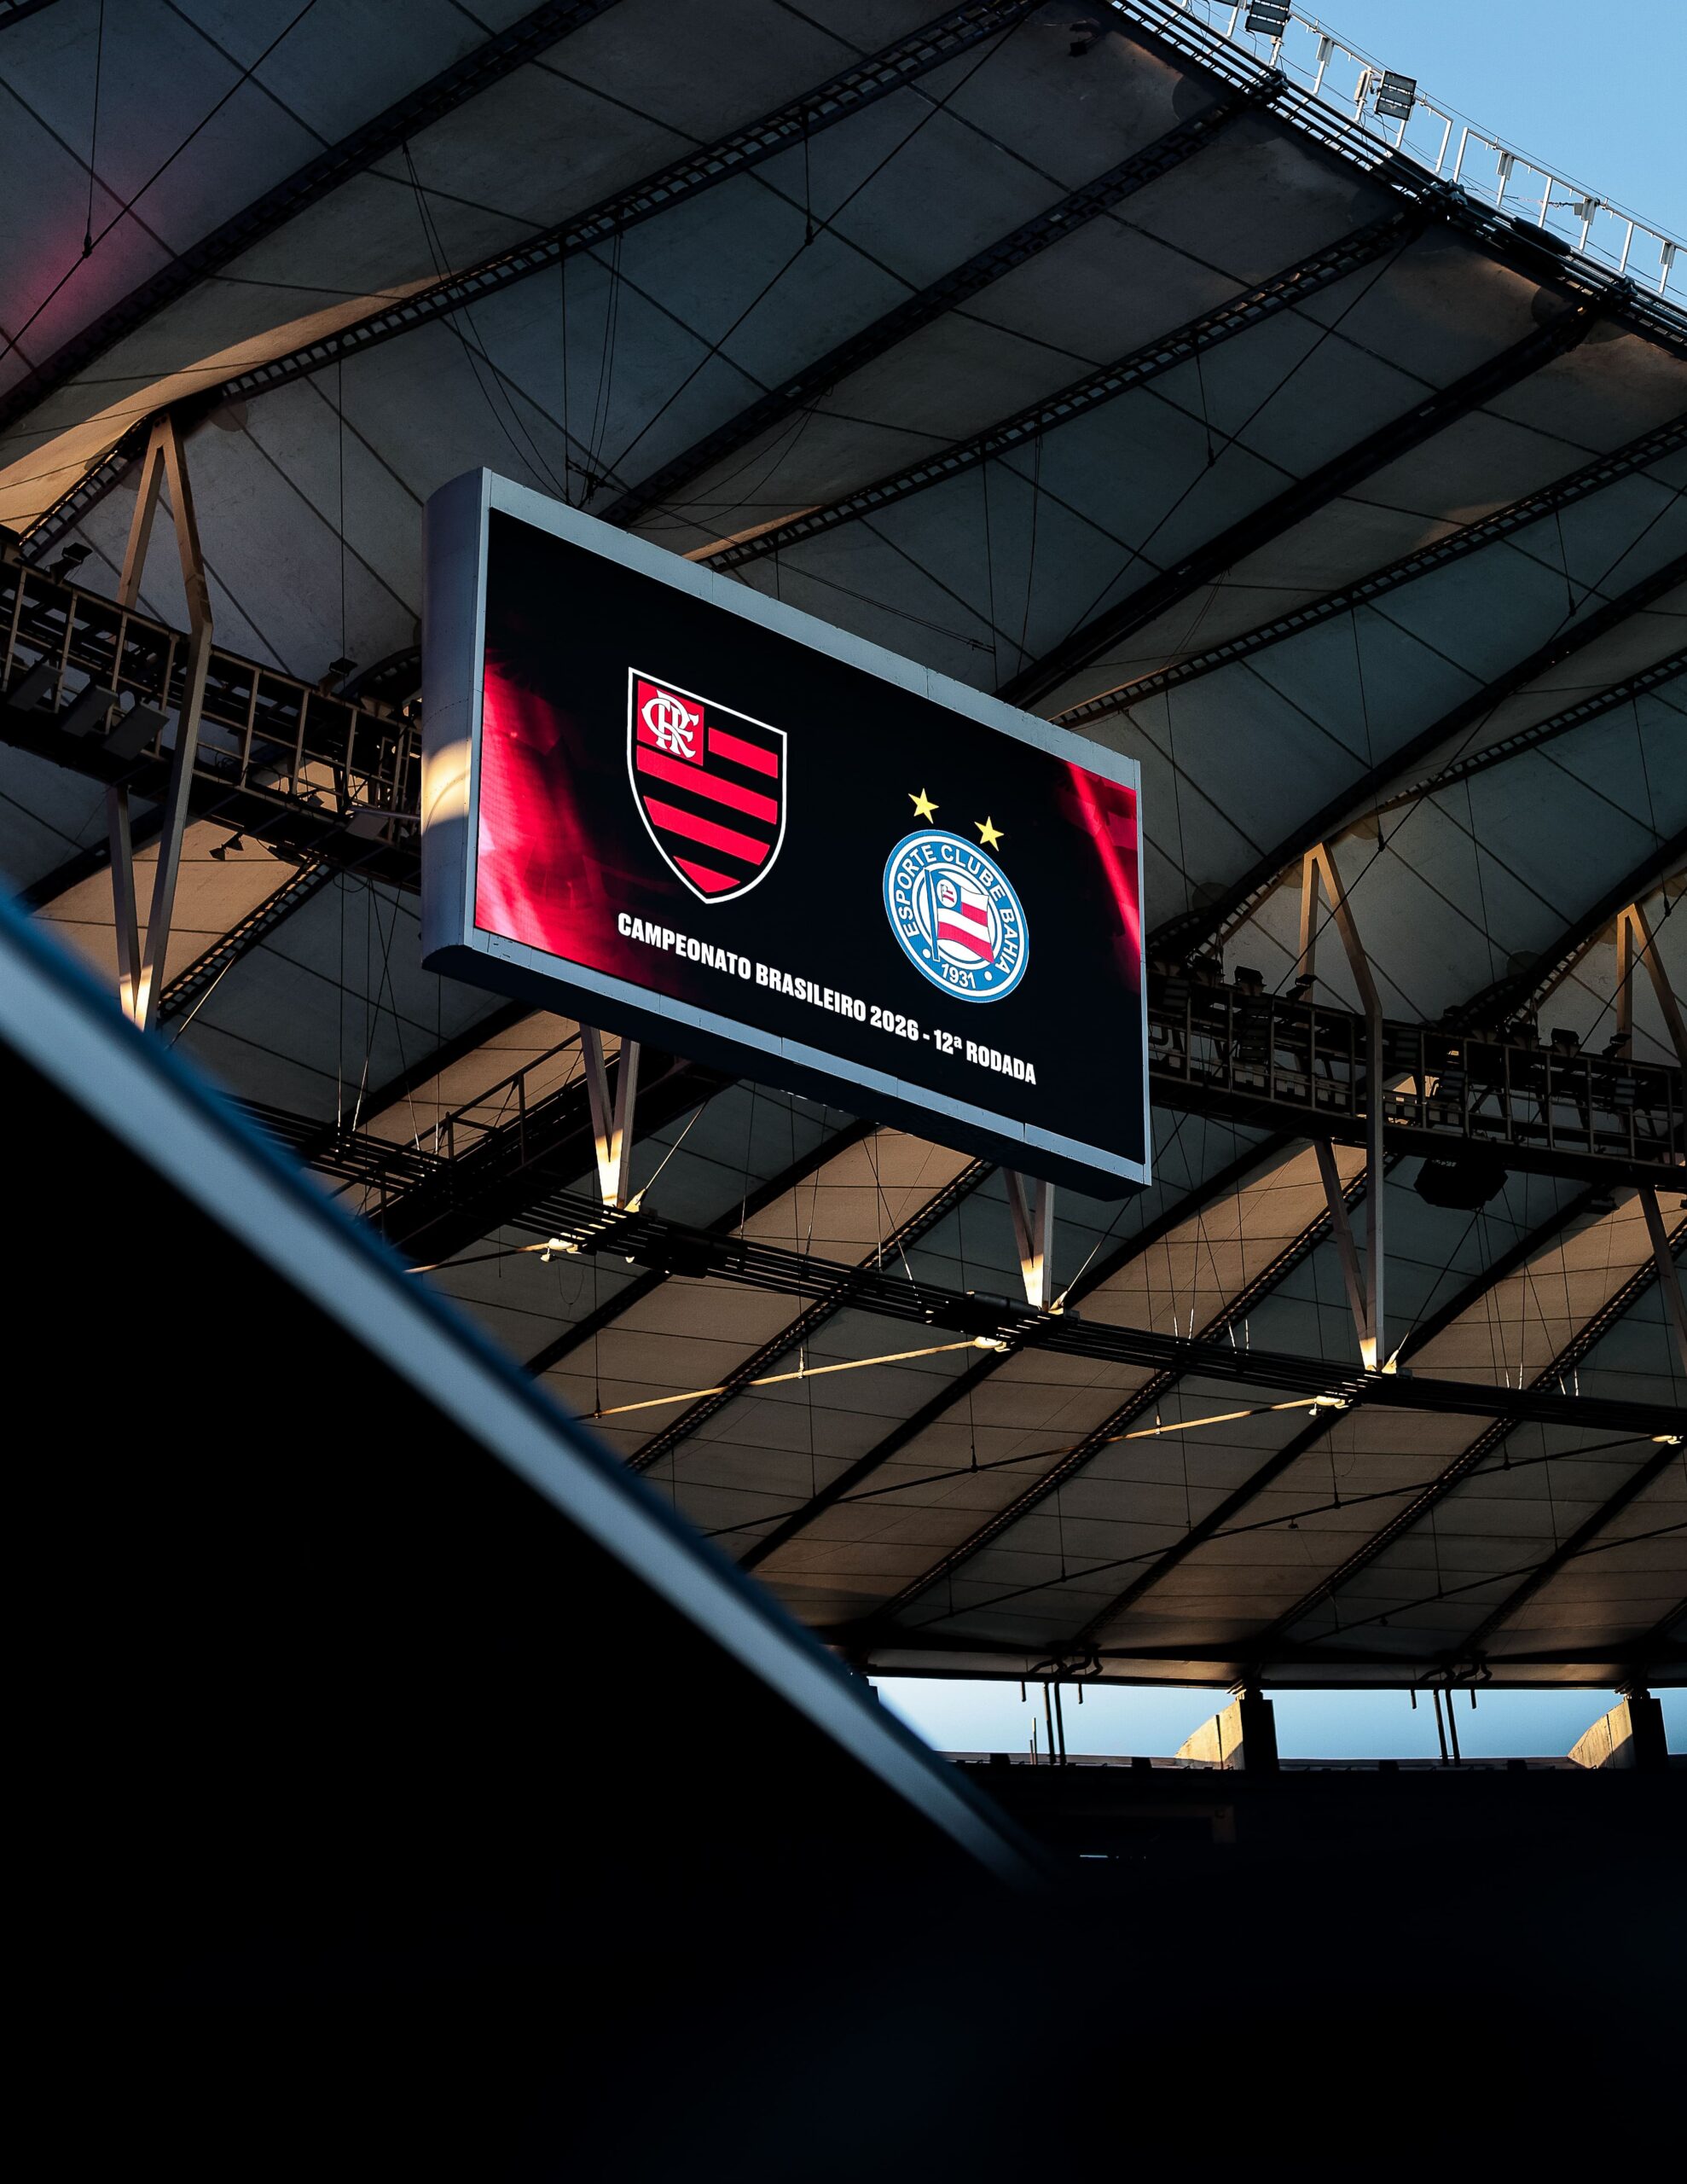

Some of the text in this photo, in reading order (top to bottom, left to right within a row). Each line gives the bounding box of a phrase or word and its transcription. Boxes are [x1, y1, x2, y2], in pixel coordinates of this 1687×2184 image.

[896, 845, 1018, 974] ESPORTE CLUBE BAHIA
[617, 913, 751, 979] CAMPEONATO
[756, 962, 866, 1021] BRASILEIRO
[870, 1006, 919, 1041] 2026
[966, 1040, 1036, 1085] RODADA
[941, 963, 977, 989] 1931
